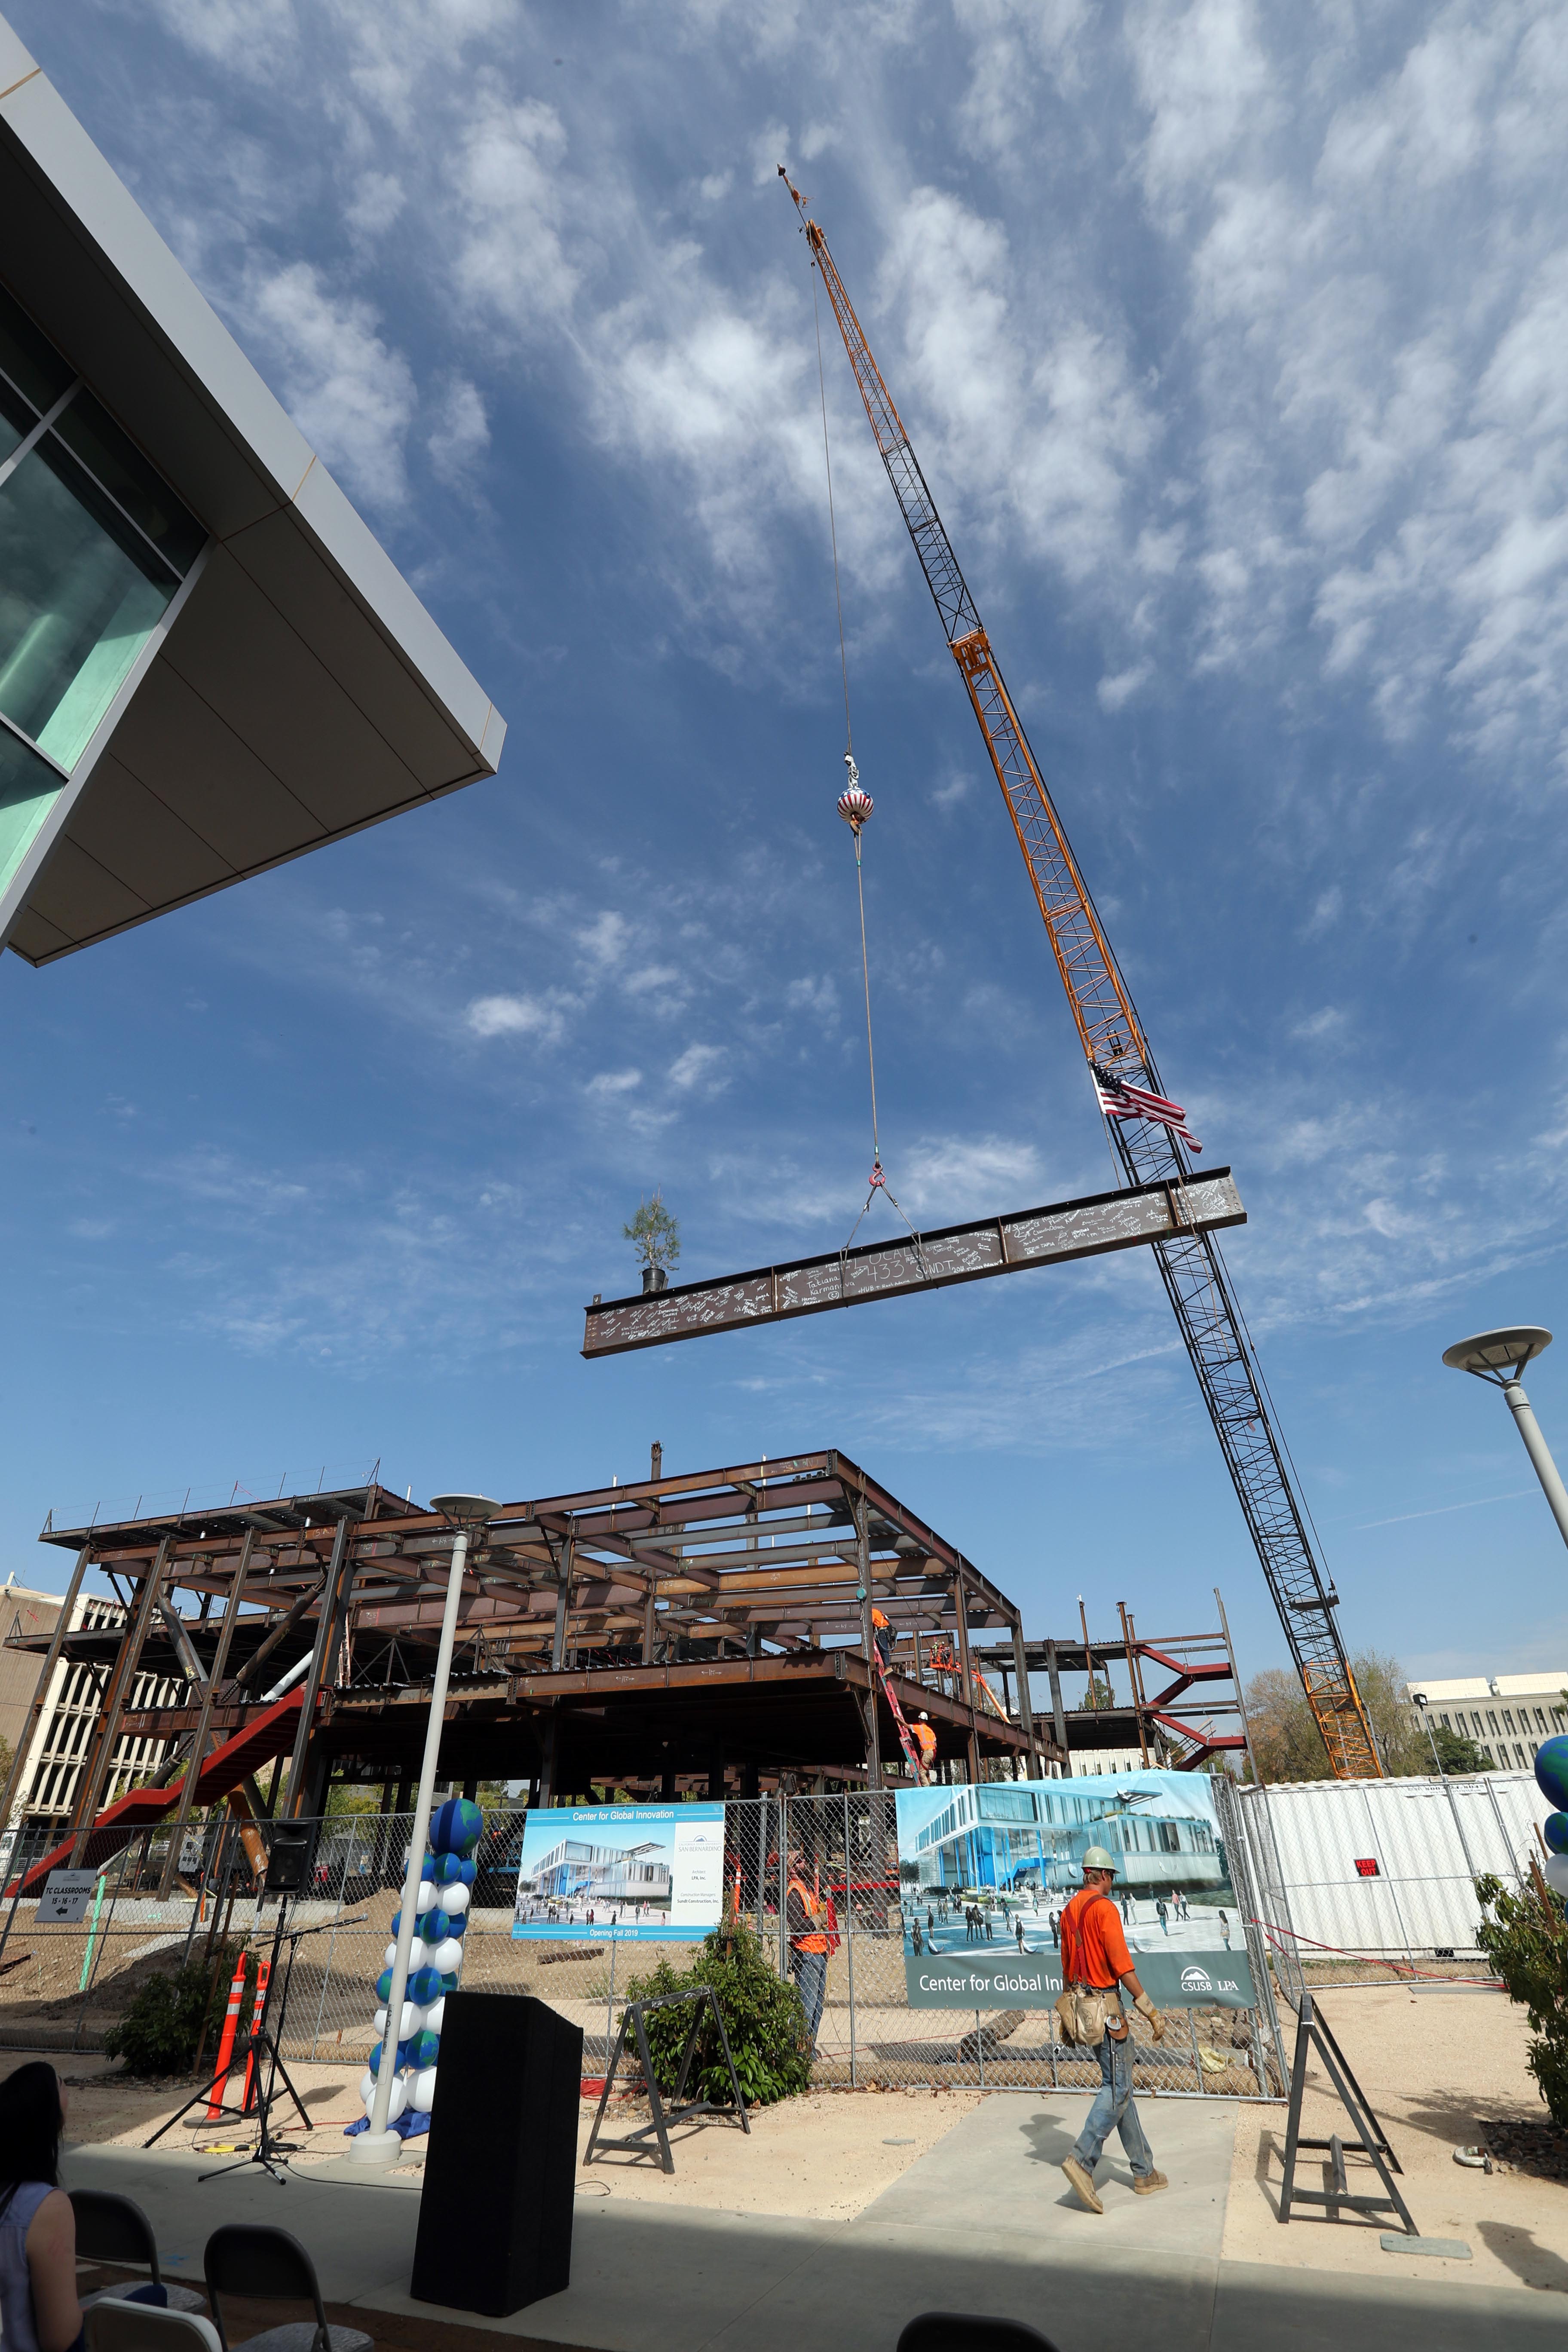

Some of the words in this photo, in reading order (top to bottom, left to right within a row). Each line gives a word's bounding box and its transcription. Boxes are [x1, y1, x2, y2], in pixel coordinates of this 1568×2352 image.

[854, 1246, 916, 1269] LOCAL
[867, 1260, 904, 1281] 433
[806, 1276, 840, 1289] Tatiana
[573, 1812, 597, 1821] Center
[599, 1811, 609, 1820] for
[610, 1810, 634, 1819] Global
[636, 1810, 674, 1819] Innovation
[1356, 1859, 1375, 1868] KEEP
[1361, 1868, 1376, 1876] OUT
[590, 1929, 612, 1938] Opening
[920, 1975, 966, 1991] Center
[970, 1974, 989, 1991] for
[994, 1974, 1041, 1991] Global
[1182, 1981, 1212, 1991] CSUSB
[1217, 1981, 1239, 1991] LPA
